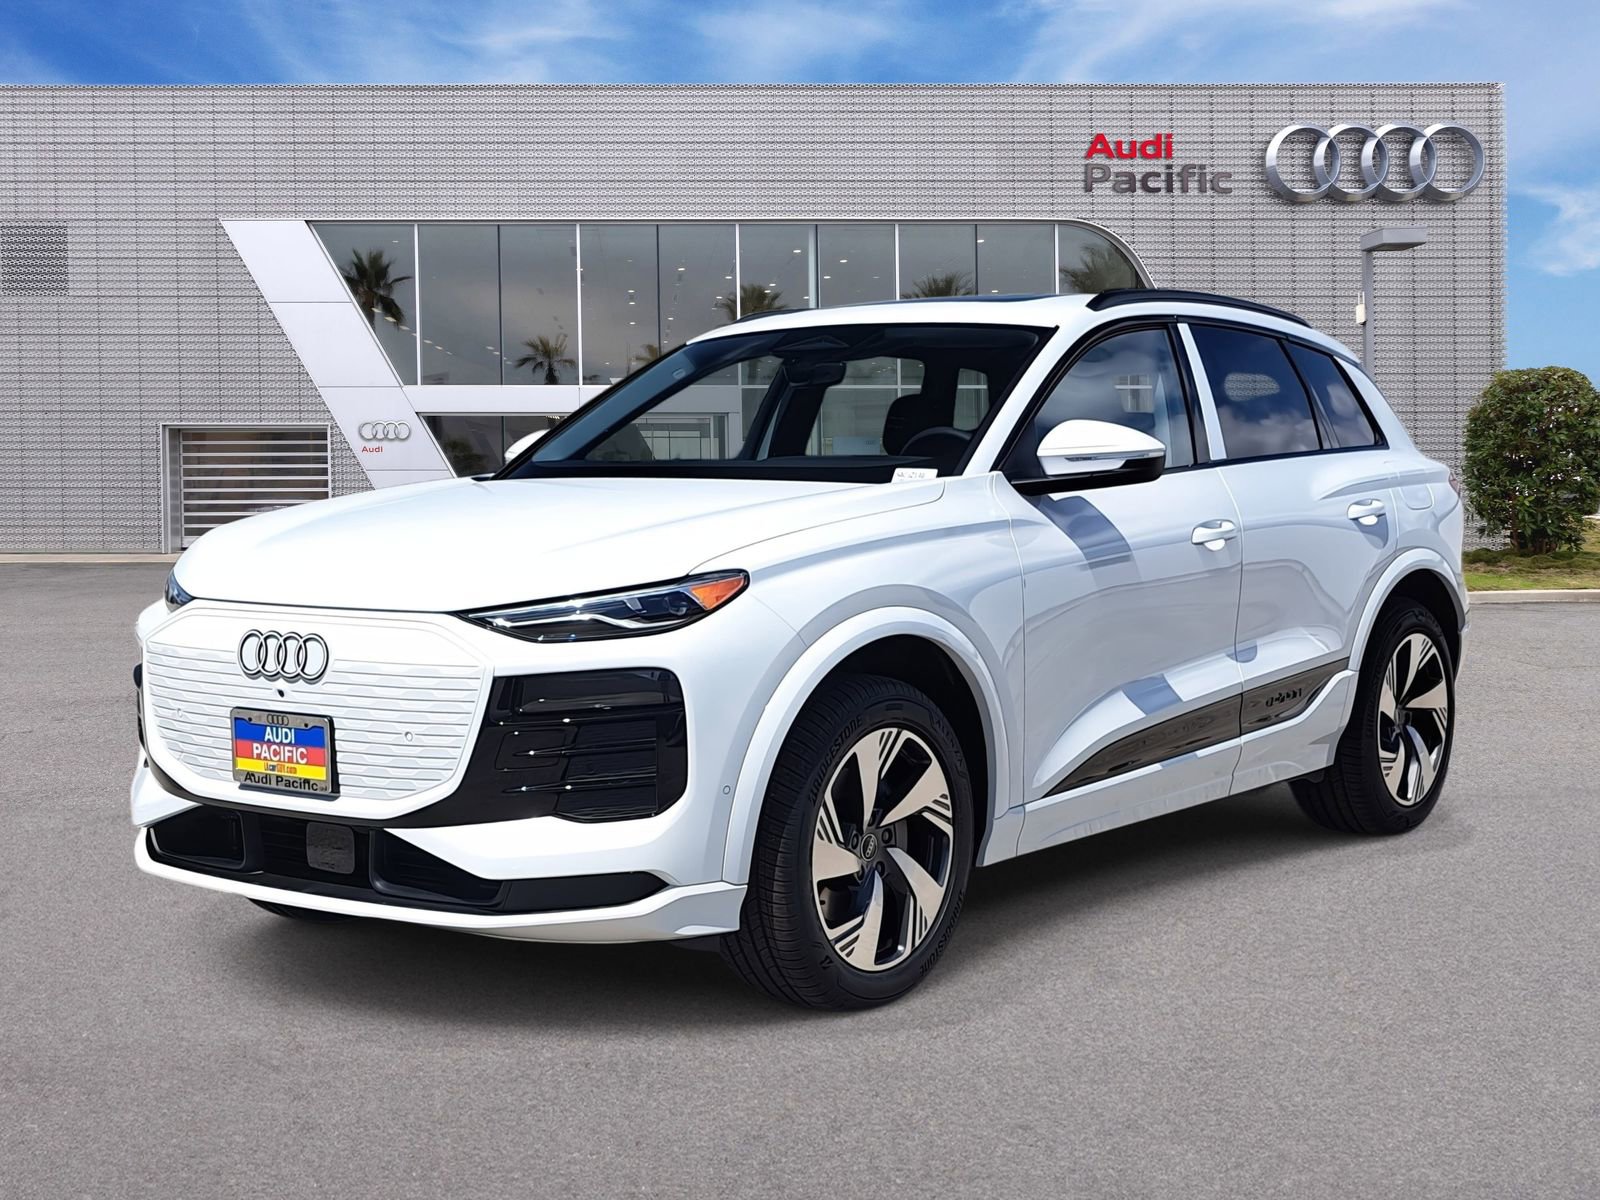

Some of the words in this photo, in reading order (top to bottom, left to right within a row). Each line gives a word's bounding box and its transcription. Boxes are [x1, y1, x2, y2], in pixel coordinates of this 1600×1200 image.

[1084, 132, 1173, 160] Audi
[1084, 163, 1232, 194] Pacific
[361, 445, 383, 453] Audi
[264, 726, 295, 744] AUDI
[252, 743, 308, 764] PACIFIC
[244, 771, 272, 786] Audi
[276, 775, 319, 792] Pacific
